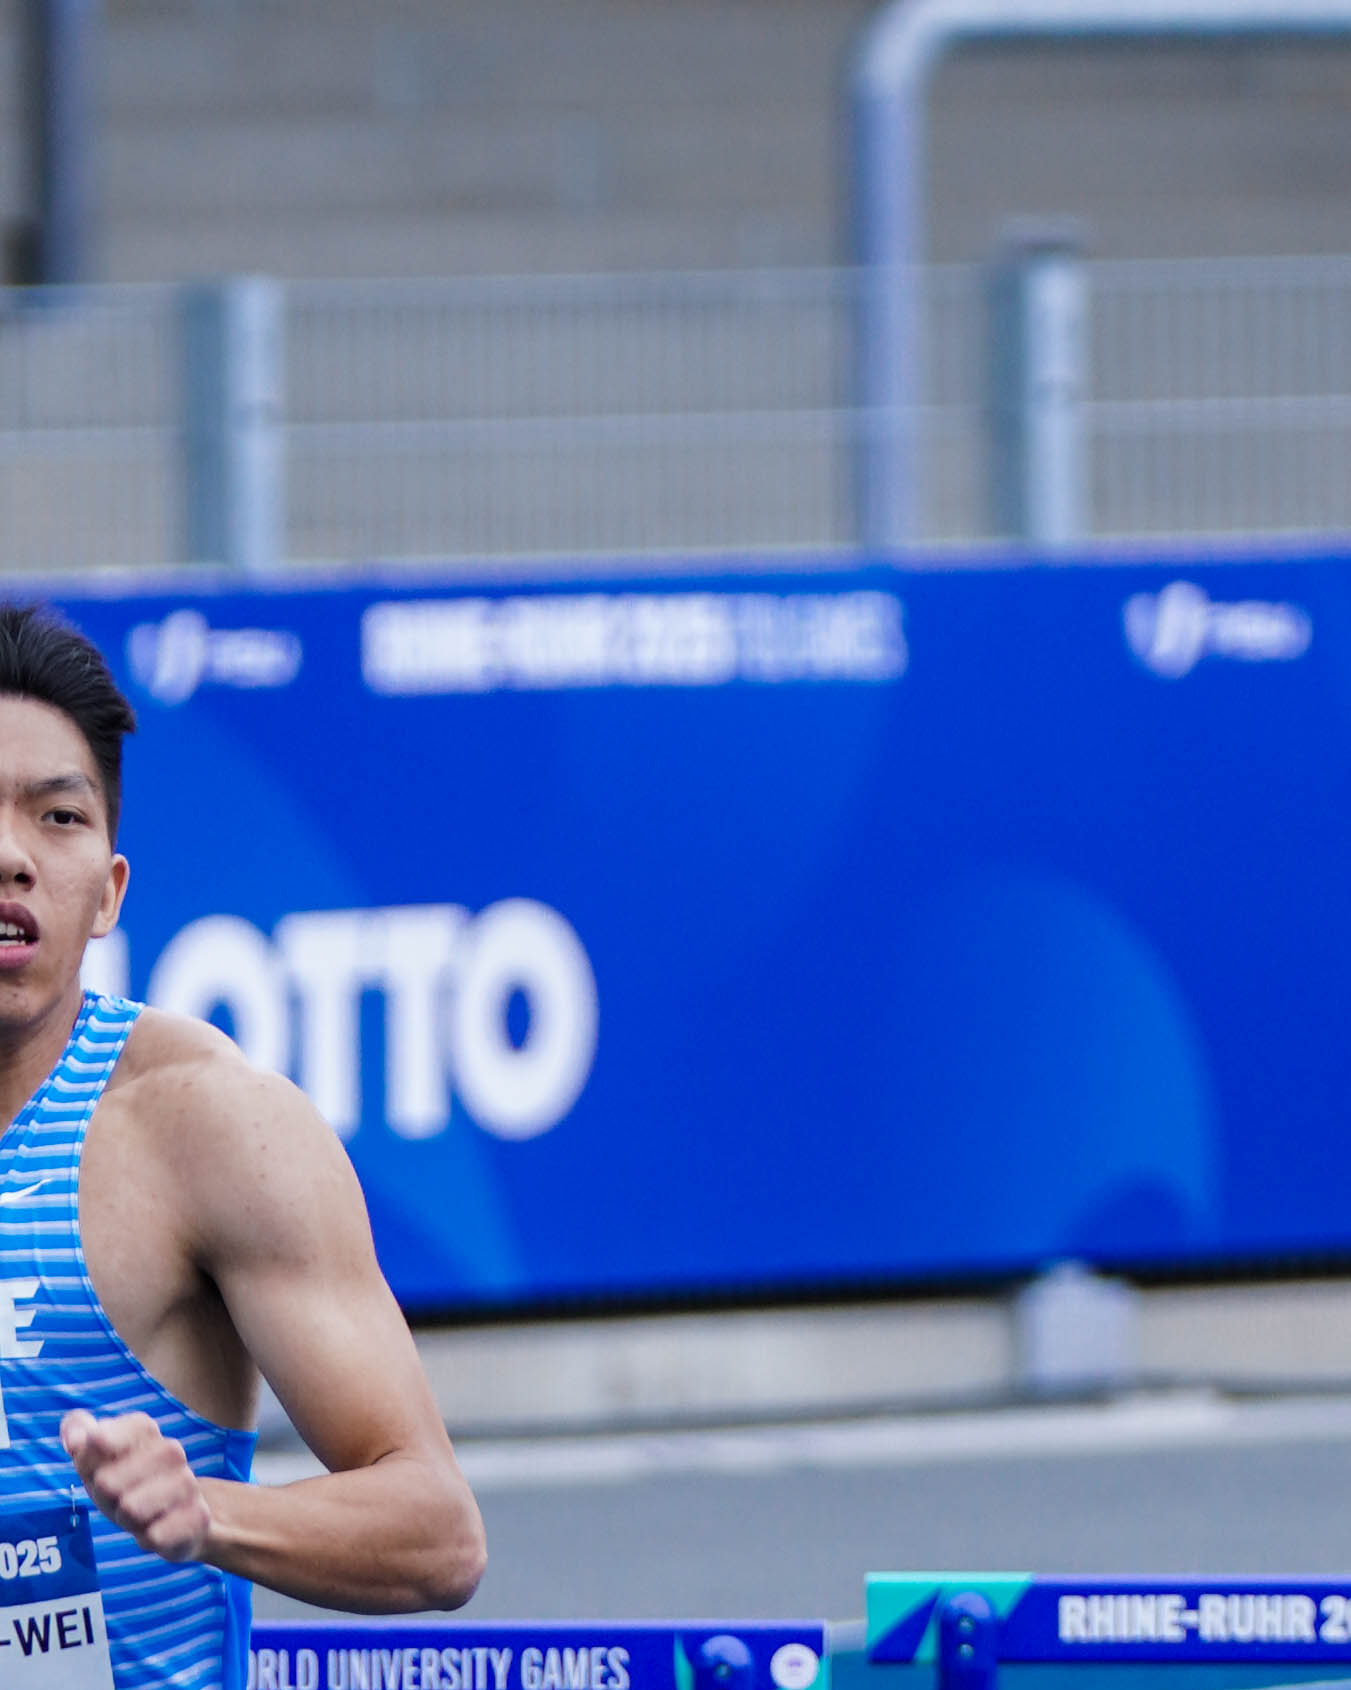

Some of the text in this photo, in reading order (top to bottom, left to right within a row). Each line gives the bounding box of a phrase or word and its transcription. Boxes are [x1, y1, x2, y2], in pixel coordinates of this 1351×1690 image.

[80, 898, 600, 1142] OTTO
[1059, 1594, 1351, 1644] RHINE-RUHR 2
